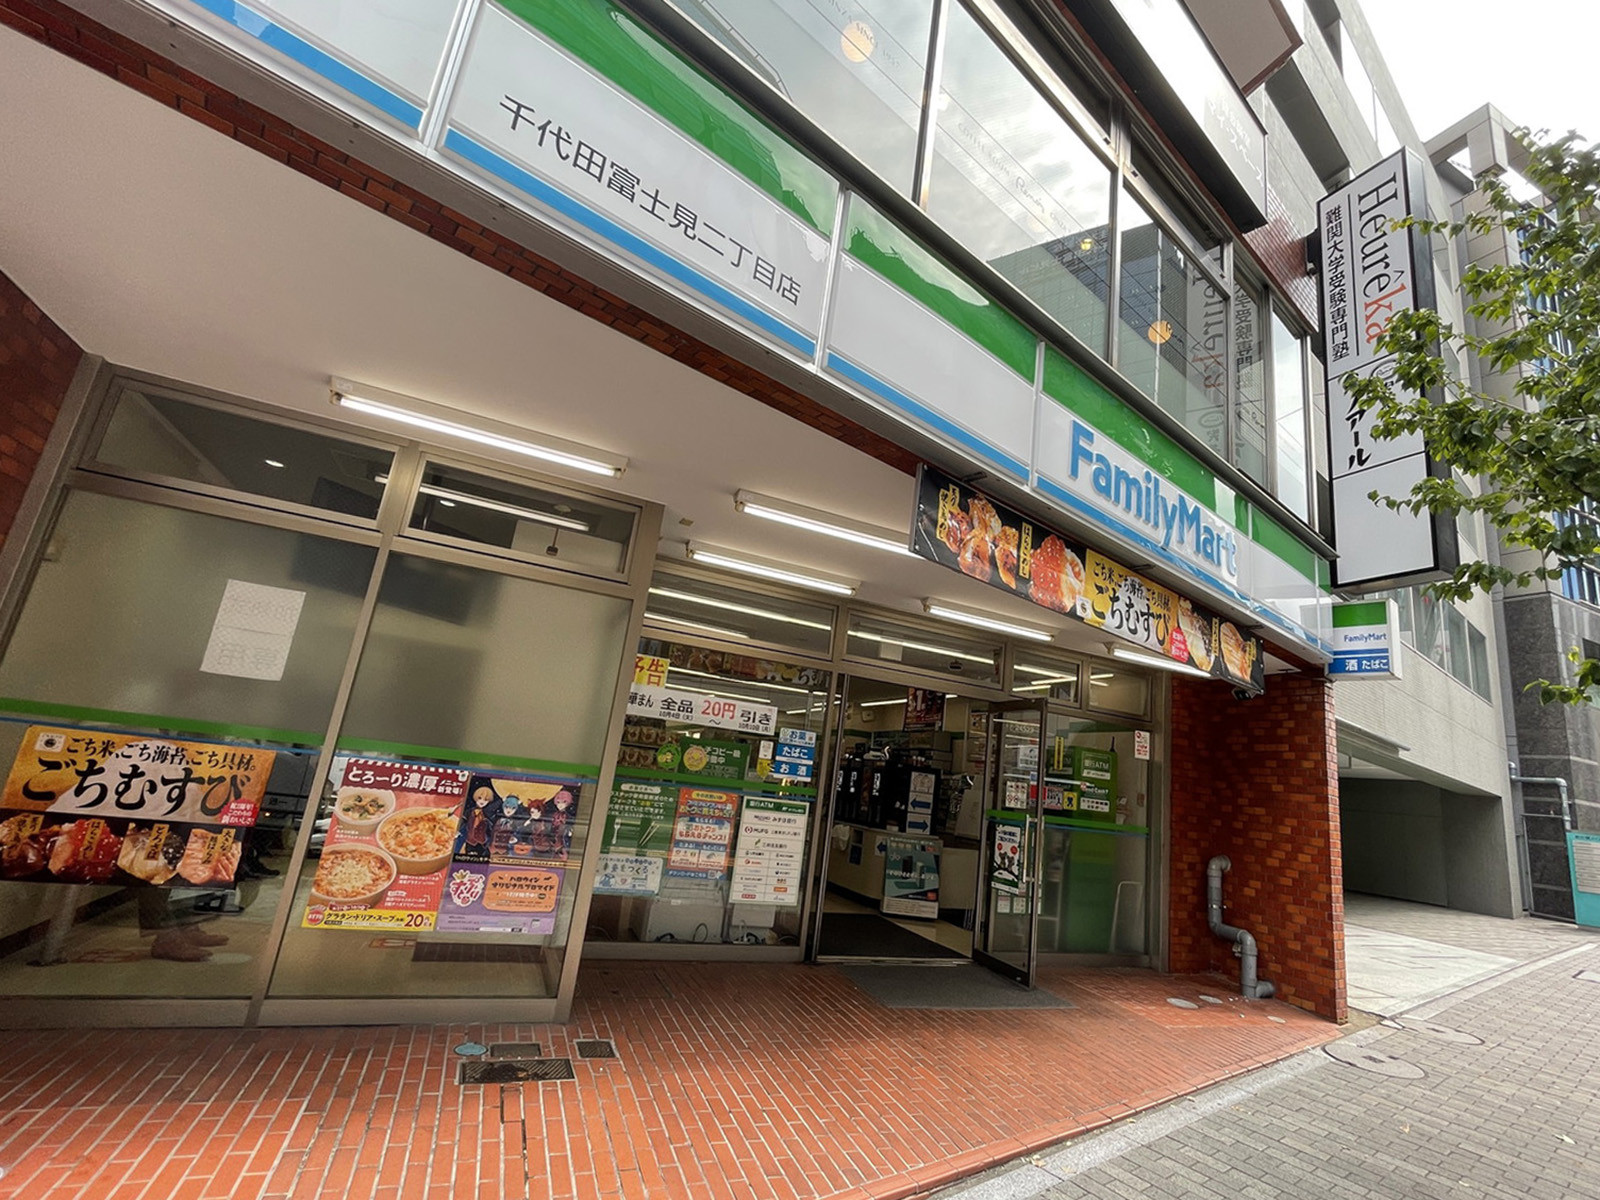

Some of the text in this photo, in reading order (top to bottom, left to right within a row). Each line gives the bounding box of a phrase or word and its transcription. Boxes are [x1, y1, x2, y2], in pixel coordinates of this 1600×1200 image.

[500, 94, 801, 306] 千代田富士見二丁目店
[1325, 205, 1349, 363] 難関大学受験専門塾
[1069, 419, 1236, 578] FamilyMart
[1092, 583, 1171, 646] ごちむすび
[1344, 633, 1387, 642] FamilyMart
[1345, 659, 1389, 671] 酒 たばこ
[660, 697, 694, 714] 全品
[701, 699, 736, 720] 20円
[740, 709, 772, 726] 引き
[66, 737, 257, 772] ごち米、ごち海苔、ごち具材。
[782, 746, 809, 758] たばこ
[22, 757, 251, 816] ごちむすび
[348, 765, 440, 792] とろーり濃厚
